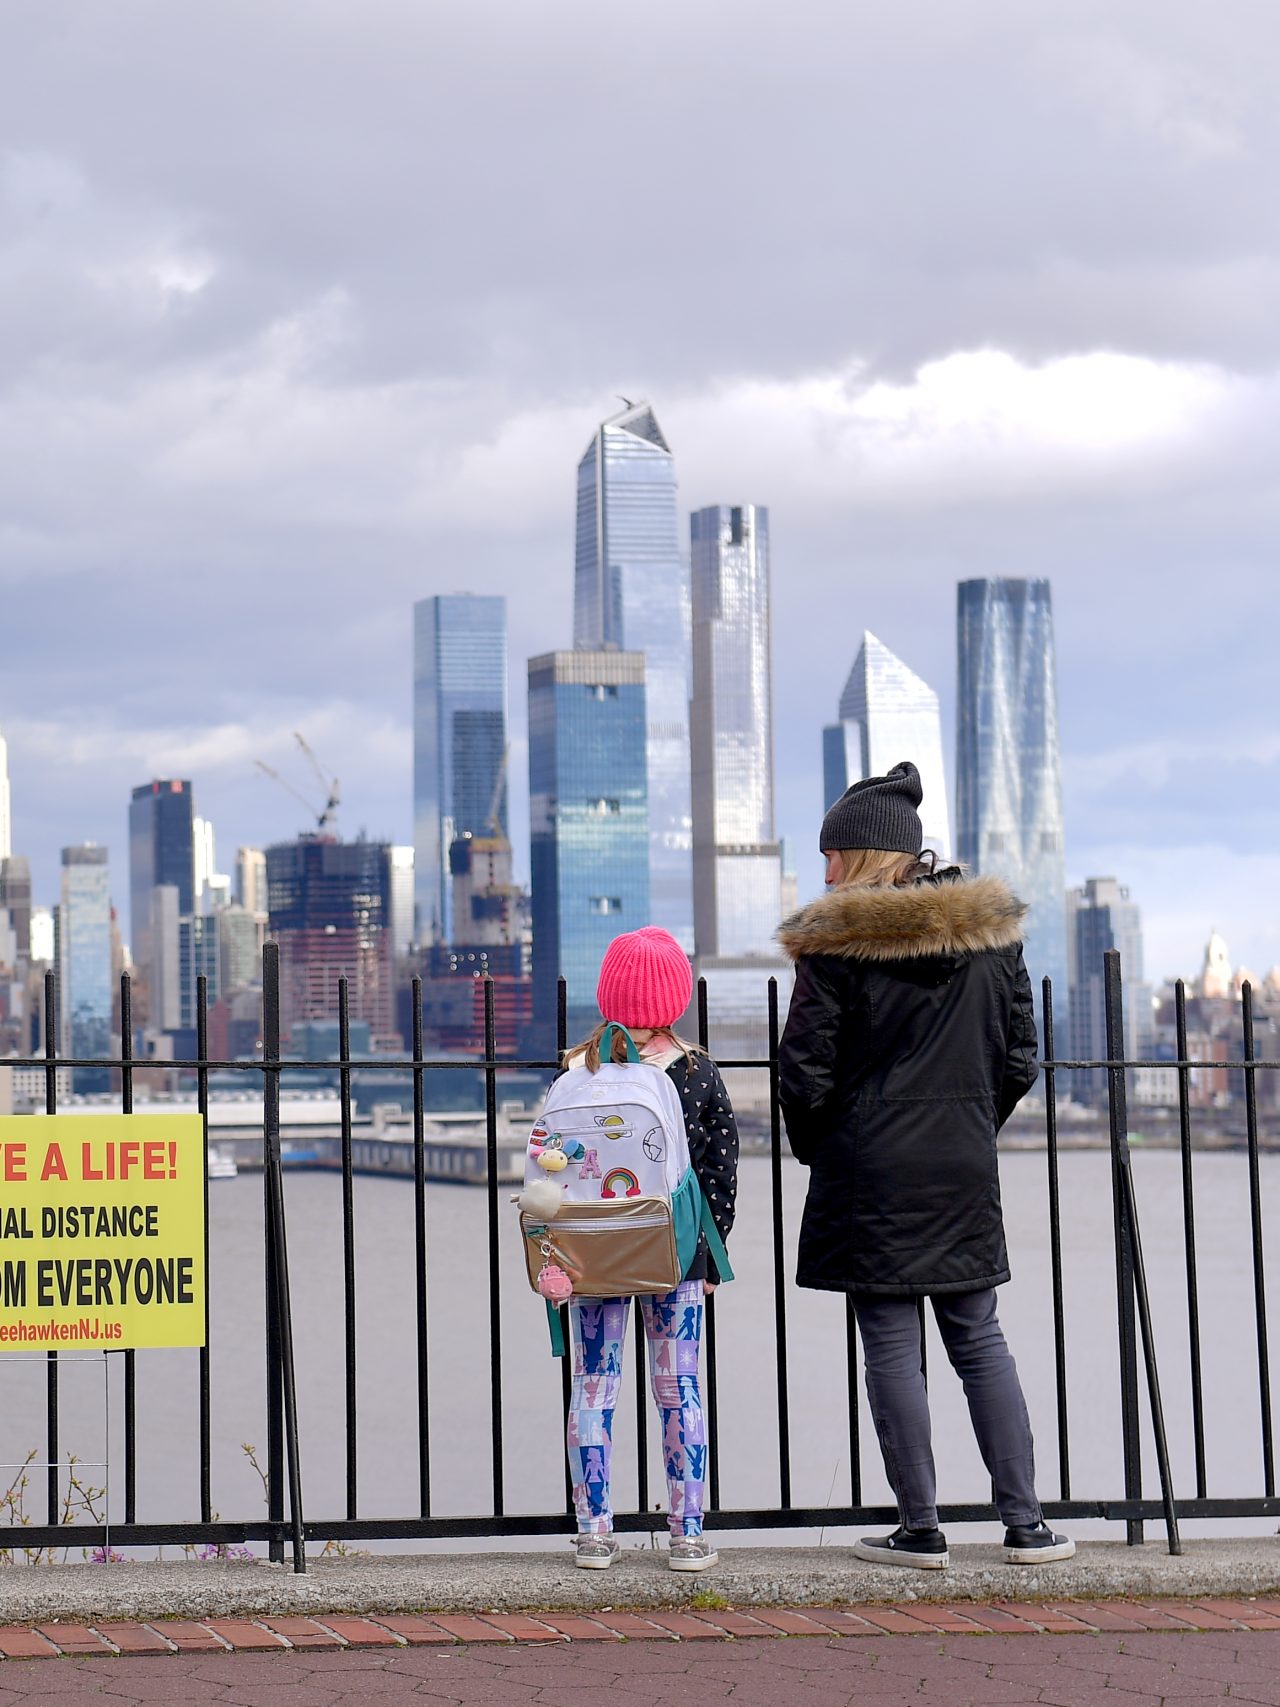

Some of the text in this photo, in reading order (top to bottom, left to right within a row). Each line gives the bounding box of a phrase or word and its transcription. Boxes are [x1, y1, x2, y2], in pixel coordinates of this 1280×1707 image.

[40, 1142, 69, 1181] A
[81, 1141, 177, 1180] LIFE!
[578, 1149, 602, 1179] A
[41, 1205, 159, 1238] DISTANCE
[37, 1257, 194, 1306] EVERYONE
